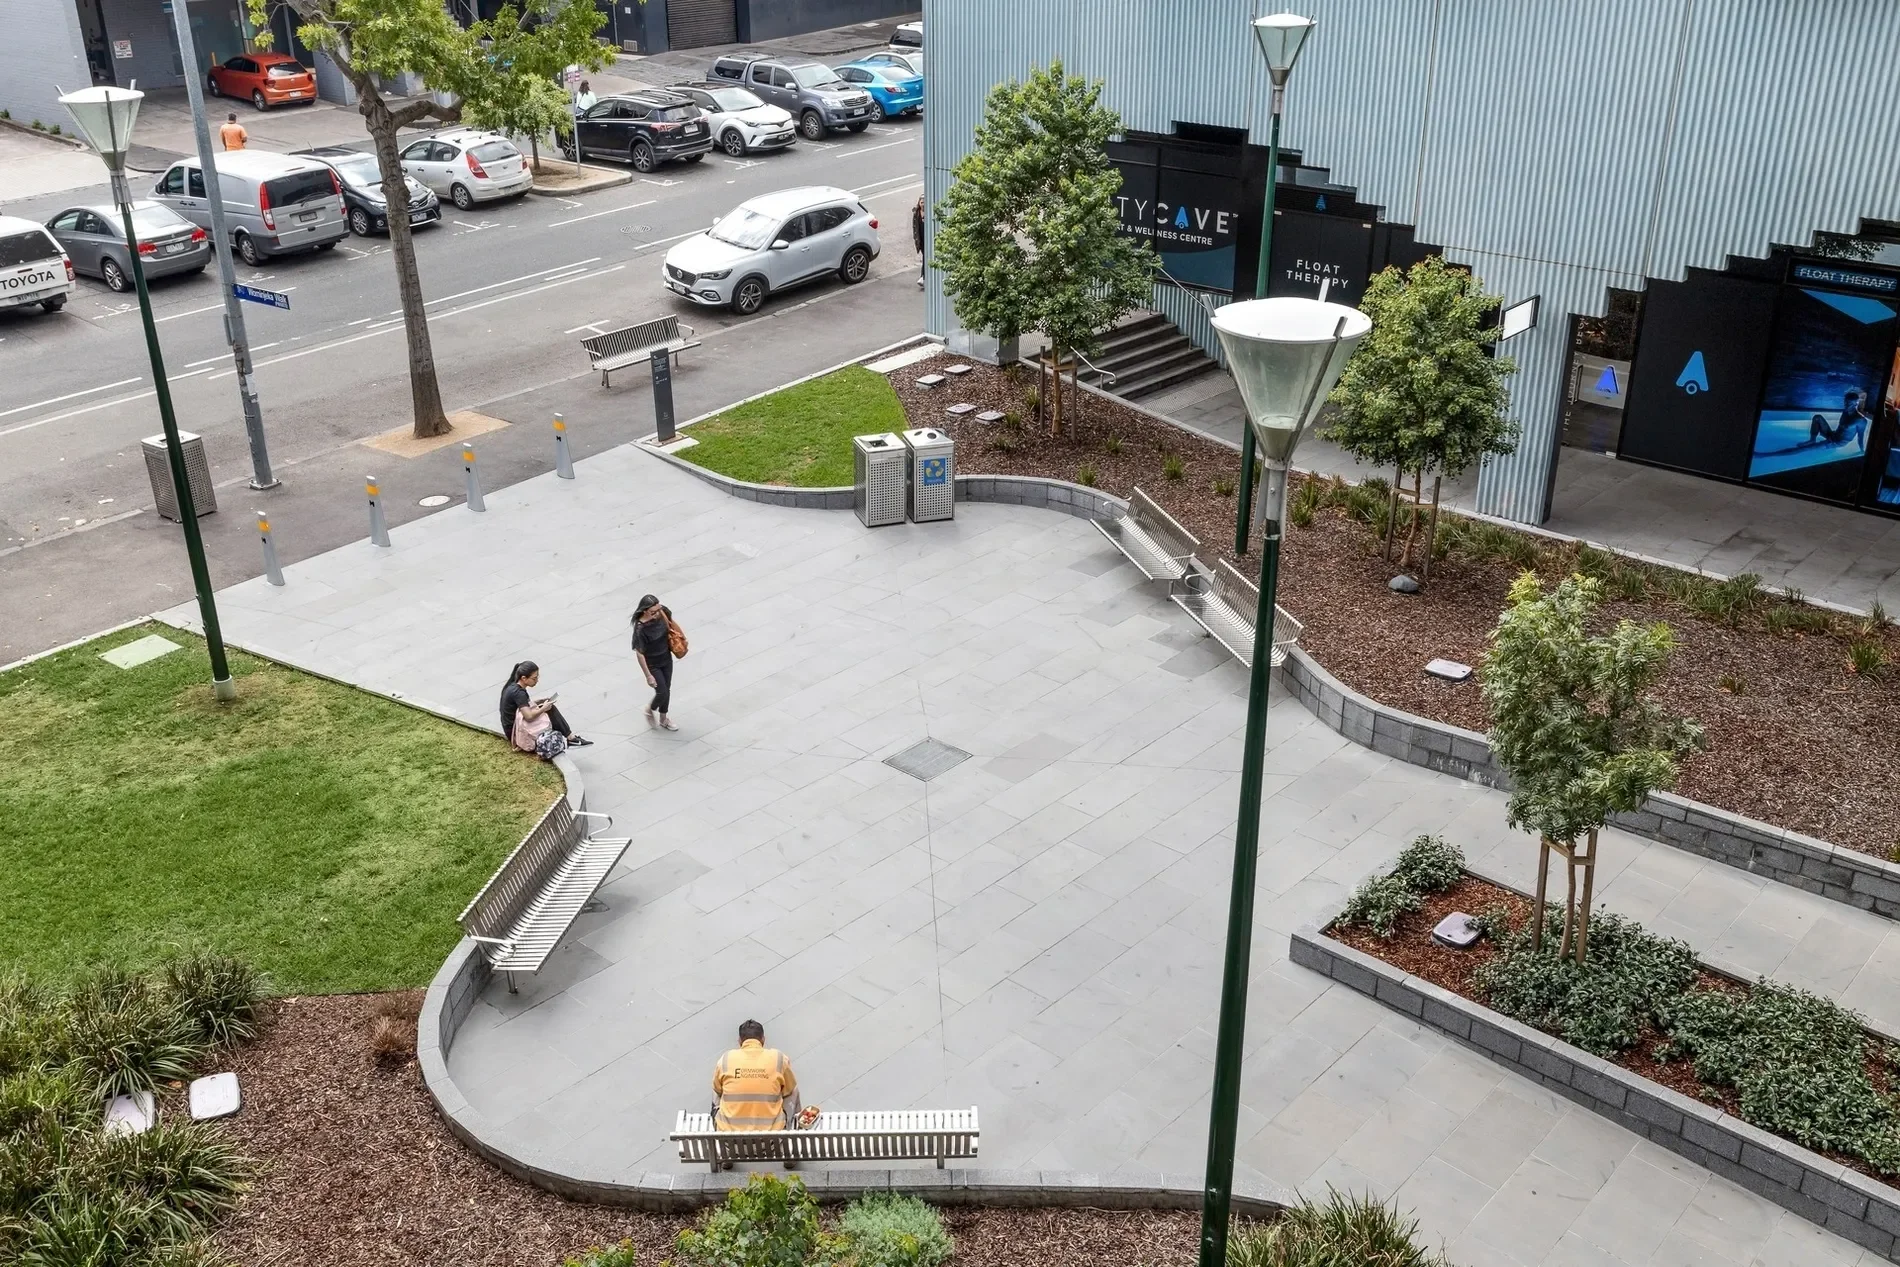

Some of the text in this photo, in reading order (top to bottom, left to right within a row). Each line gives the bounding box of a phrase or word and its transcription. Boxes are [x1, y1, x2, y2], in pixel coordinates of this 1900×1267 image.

[1127, 224, 1133, 233] &
[1180, 233, 1213, 246] CENTRE
[1296, 259, 1340, 275] FLOAT
[0, 271, 55, 290] TOYOTA
[1286, 270, 1349, 289] THERPY
[1800, 268, 1894, 289] FLOAT THERAPY
